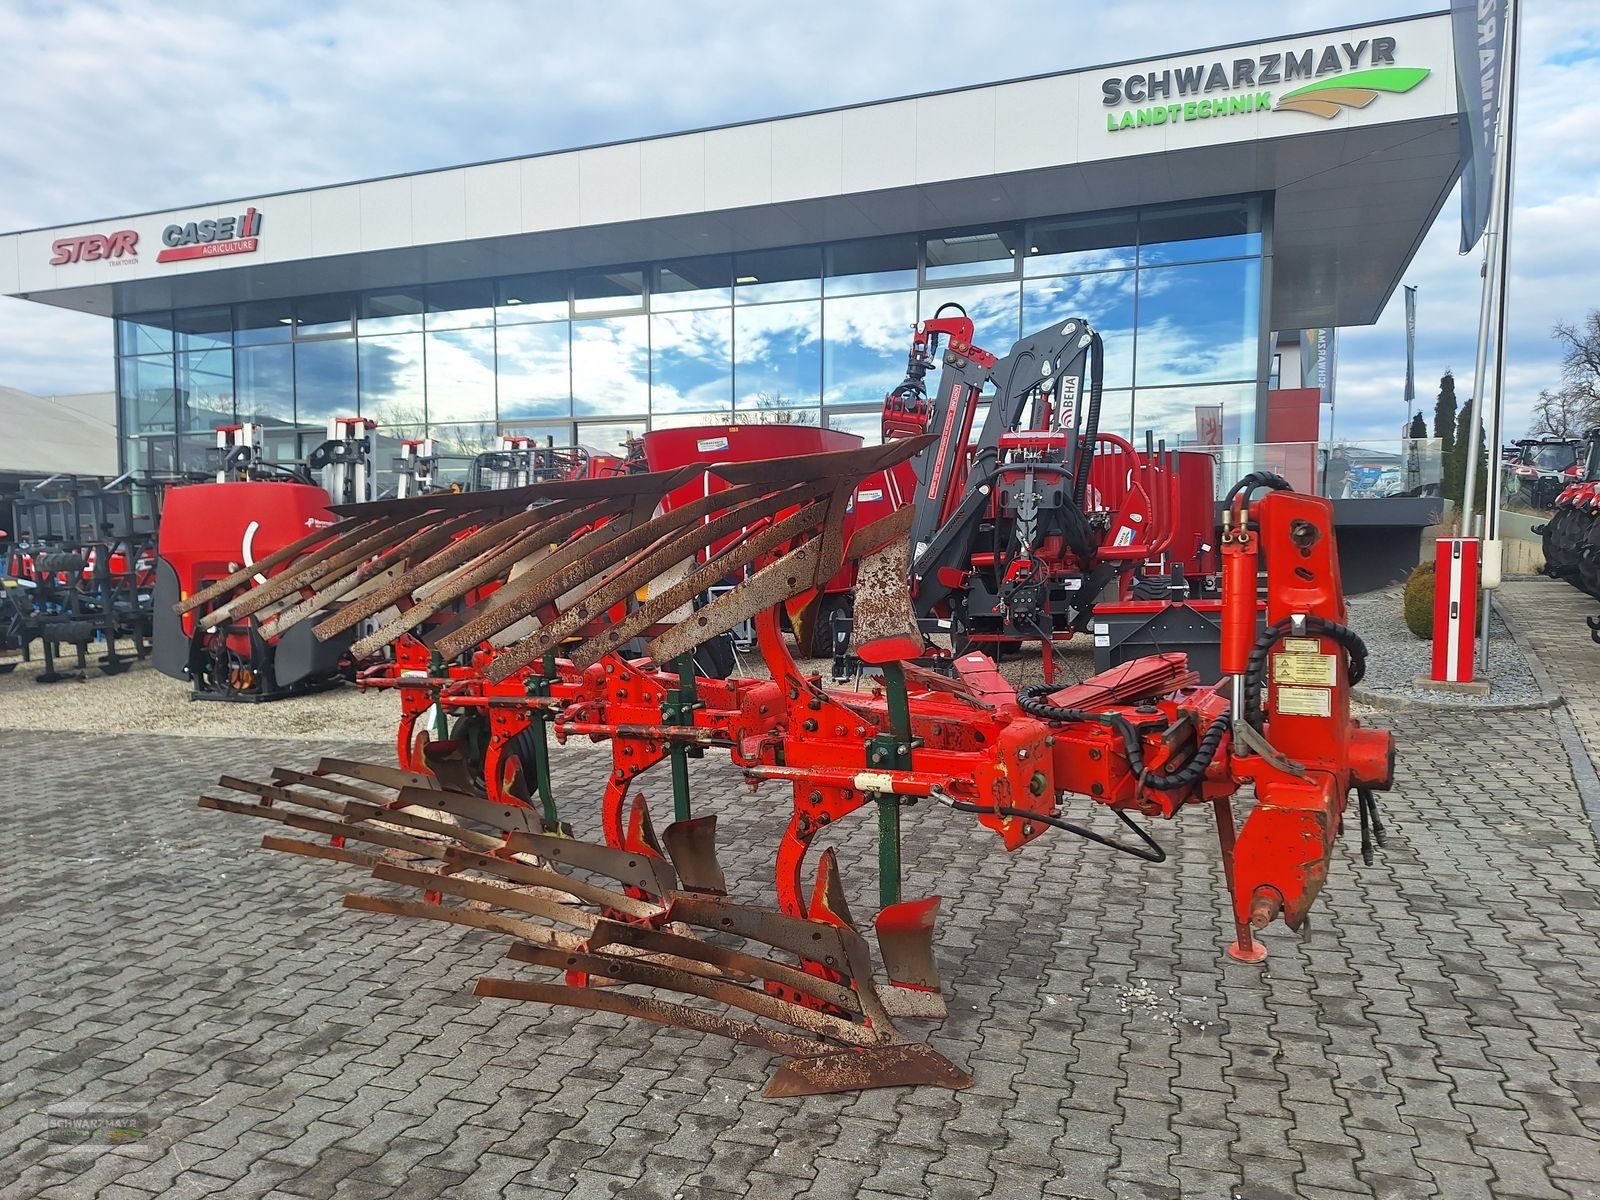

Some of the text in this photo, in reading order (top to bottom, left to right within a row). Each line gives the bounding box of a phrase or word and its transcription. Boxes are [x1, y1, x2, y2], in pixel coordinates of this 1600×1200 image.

[1101, 36, 1398, 106] SCHWARZMAYR
[1106, 91, 1272, 131] LANDTECHNIK
[49, 229, 139, 266] STEYR
[202, 240, 252, 254] AGRICULTURE
[1062, 377, 1076, 408] BEHA
